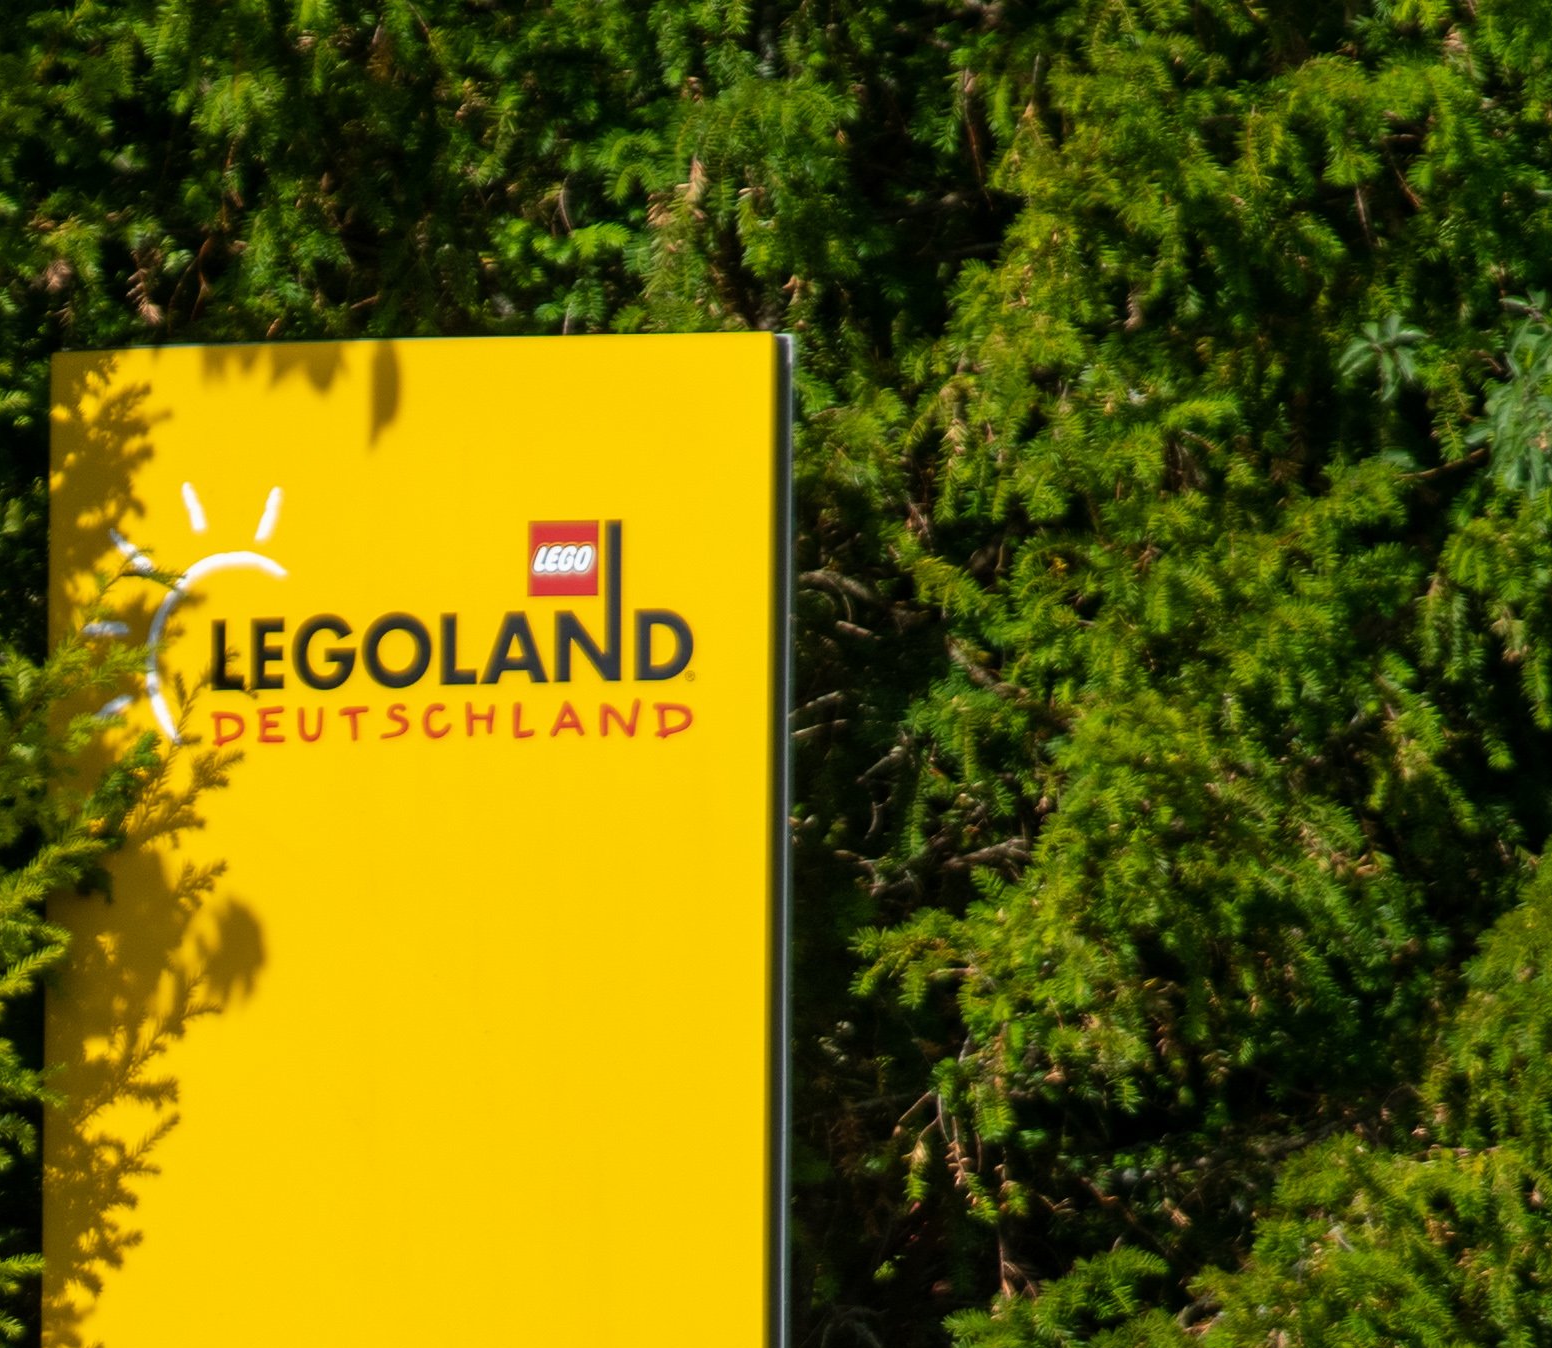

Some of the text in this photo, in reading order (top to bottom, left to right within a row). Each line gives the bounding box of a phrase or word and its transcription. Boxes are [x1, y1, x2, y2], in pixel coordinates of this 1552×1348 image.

[532, 545, 593, 573] LEGO
[211, 519, 694, 691] LEGOLAND
[210, 698, 693, 748] DEUTSCHLAND
